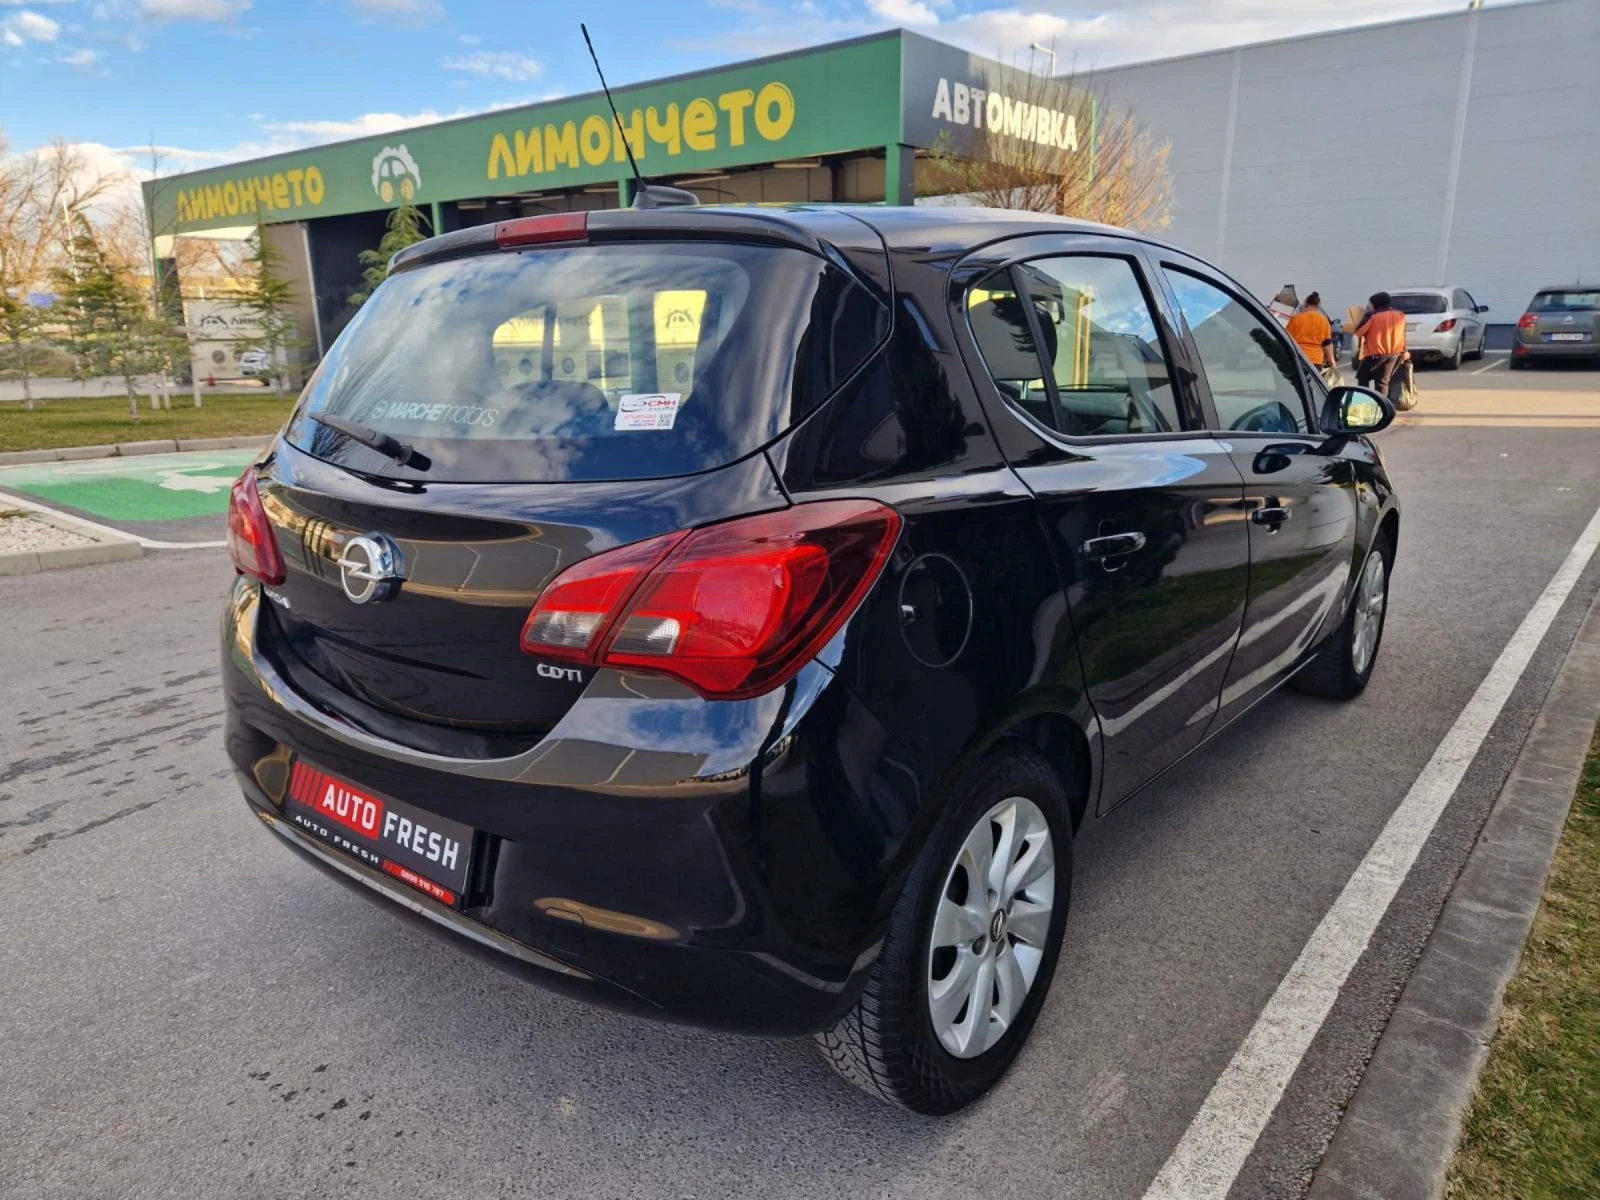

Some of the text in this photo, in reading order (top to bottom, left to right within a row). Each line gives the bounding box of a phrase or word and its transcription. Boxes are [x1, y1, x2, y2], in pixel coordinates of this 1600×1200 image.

[931, 77, 1078, 153] АВТОМИВКА
[536, 663, 582, 682] CDTI
[295, 815, 379, 864] AUTO FRESH
[323, 784, 459, 870] AUTO FRESH
